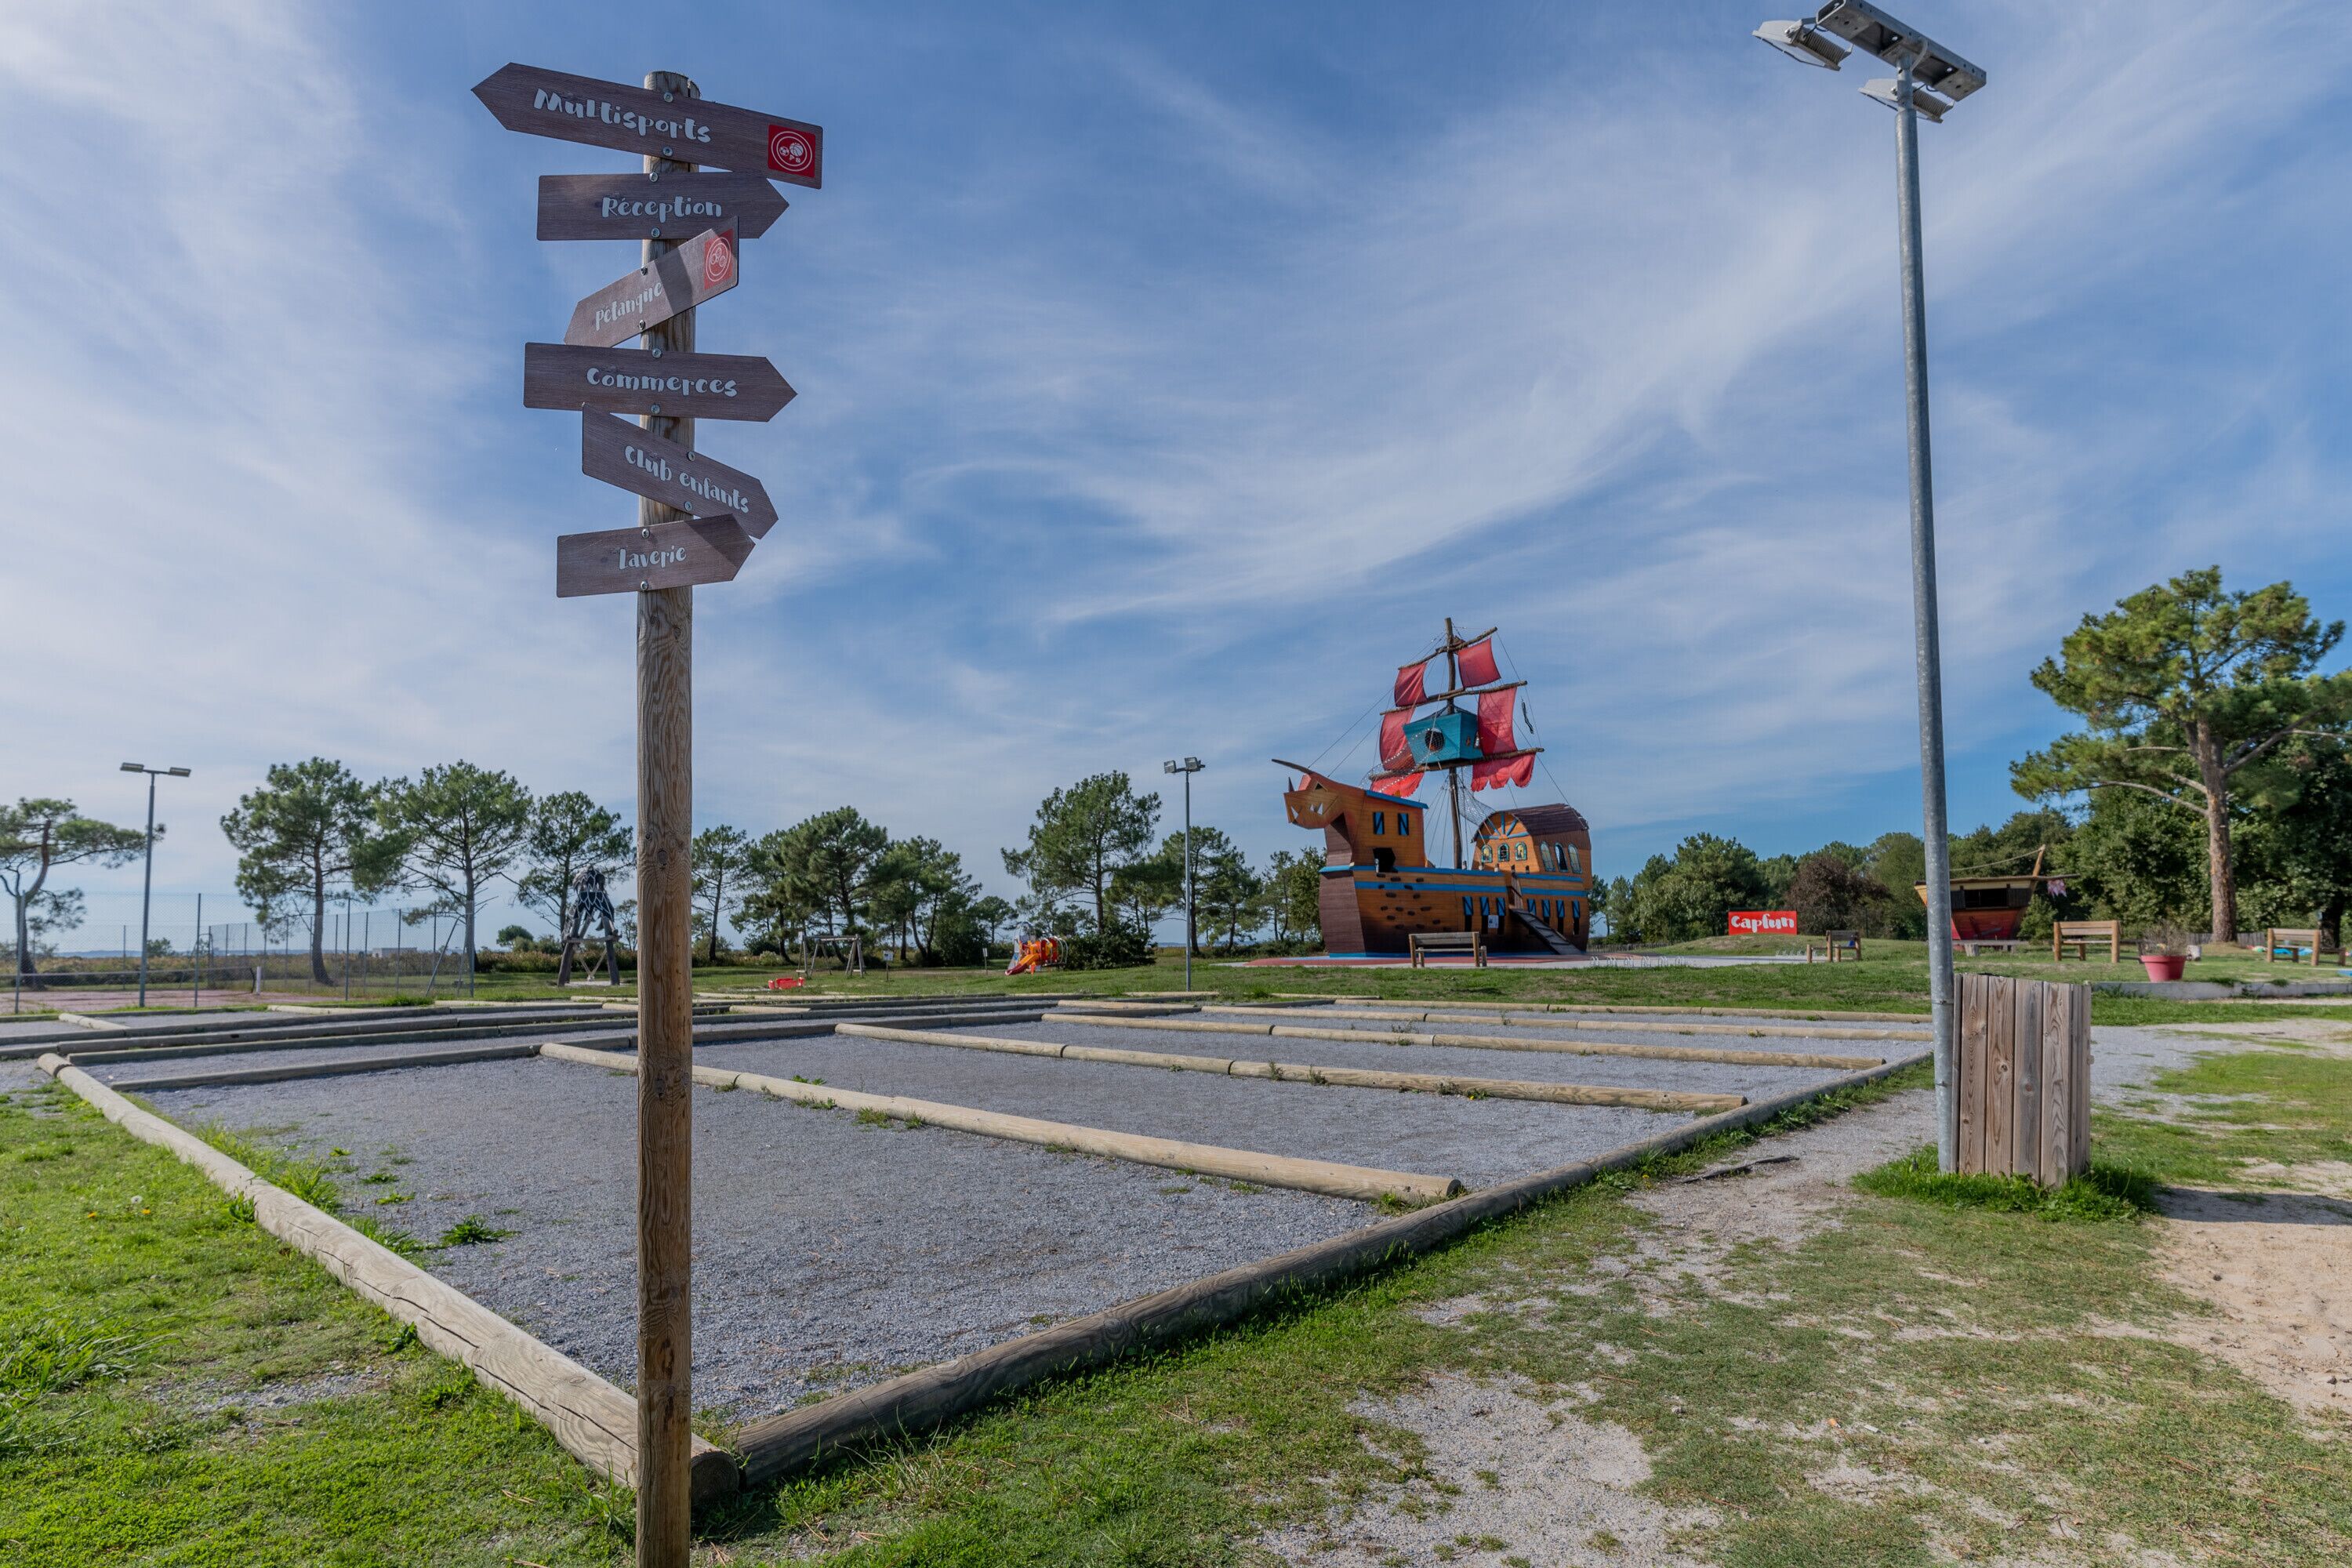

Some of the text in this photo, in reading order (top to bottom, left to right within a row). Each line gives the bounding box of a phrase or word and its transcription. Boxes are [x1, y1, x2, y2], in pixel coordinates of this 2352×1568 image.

[533, 88, 711, 143] Multisports
[602, 196, 722, 223] Réception
[595, 281, 663, 331] Pétanque
[586, 368, 737, 397] Commerces
[624, 445, 749, 514] Club enfants
[618, 545, 687, 570] Laverie
[1731, 913, 1795, 933] Capfun
